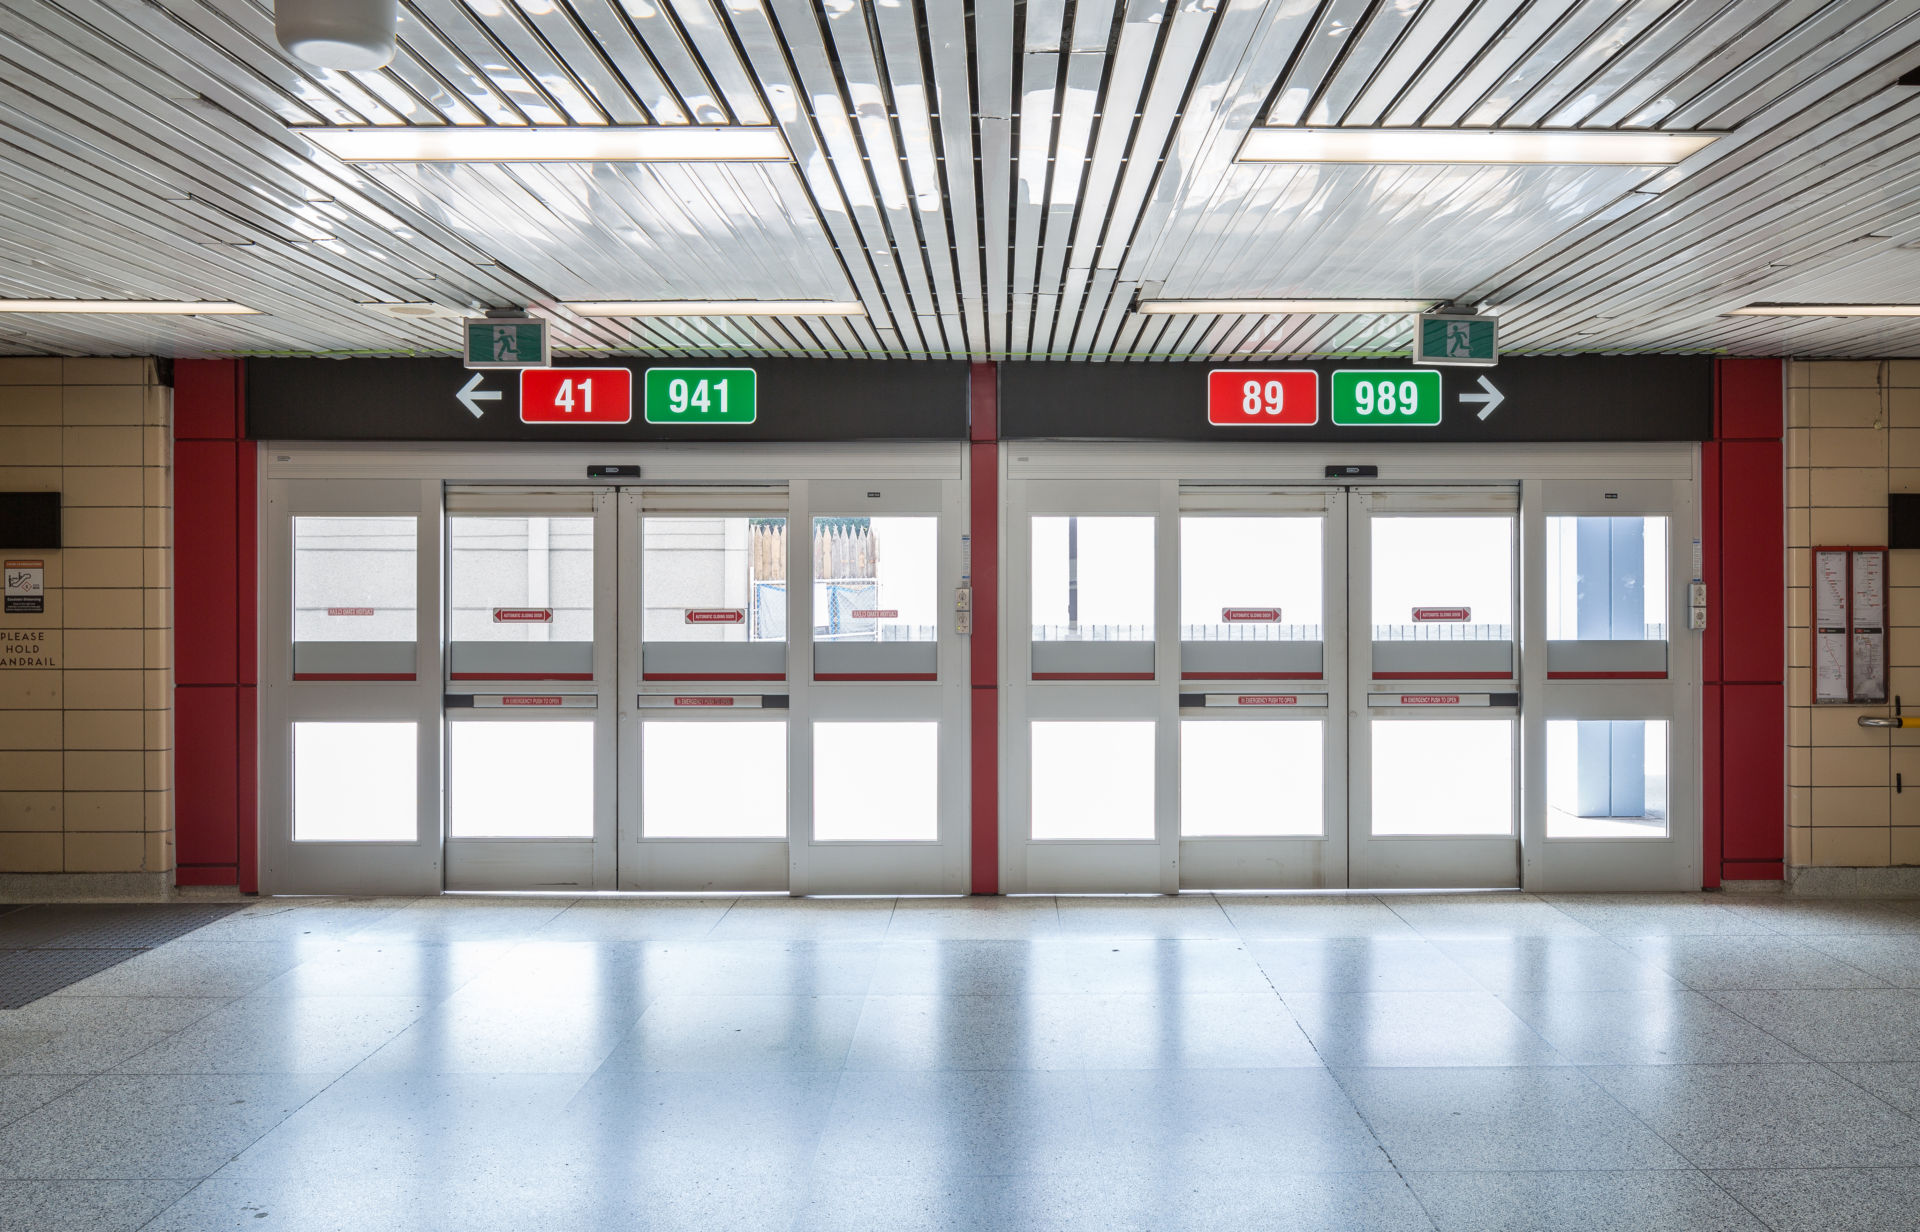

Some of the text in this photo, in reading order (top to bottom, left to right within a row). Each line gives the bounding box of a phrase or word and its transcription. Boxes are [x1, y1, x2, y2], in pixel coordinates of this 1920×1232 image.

[554, 378, 592, 413] 41
[669, 378, 728, 414] 941
[1242, 380, 1284, 415] 89
[1354, 380, 1418, 415] 989
[0, 632, 44, 641] PLEASE
[6, 645, 40, 654] HOLD
